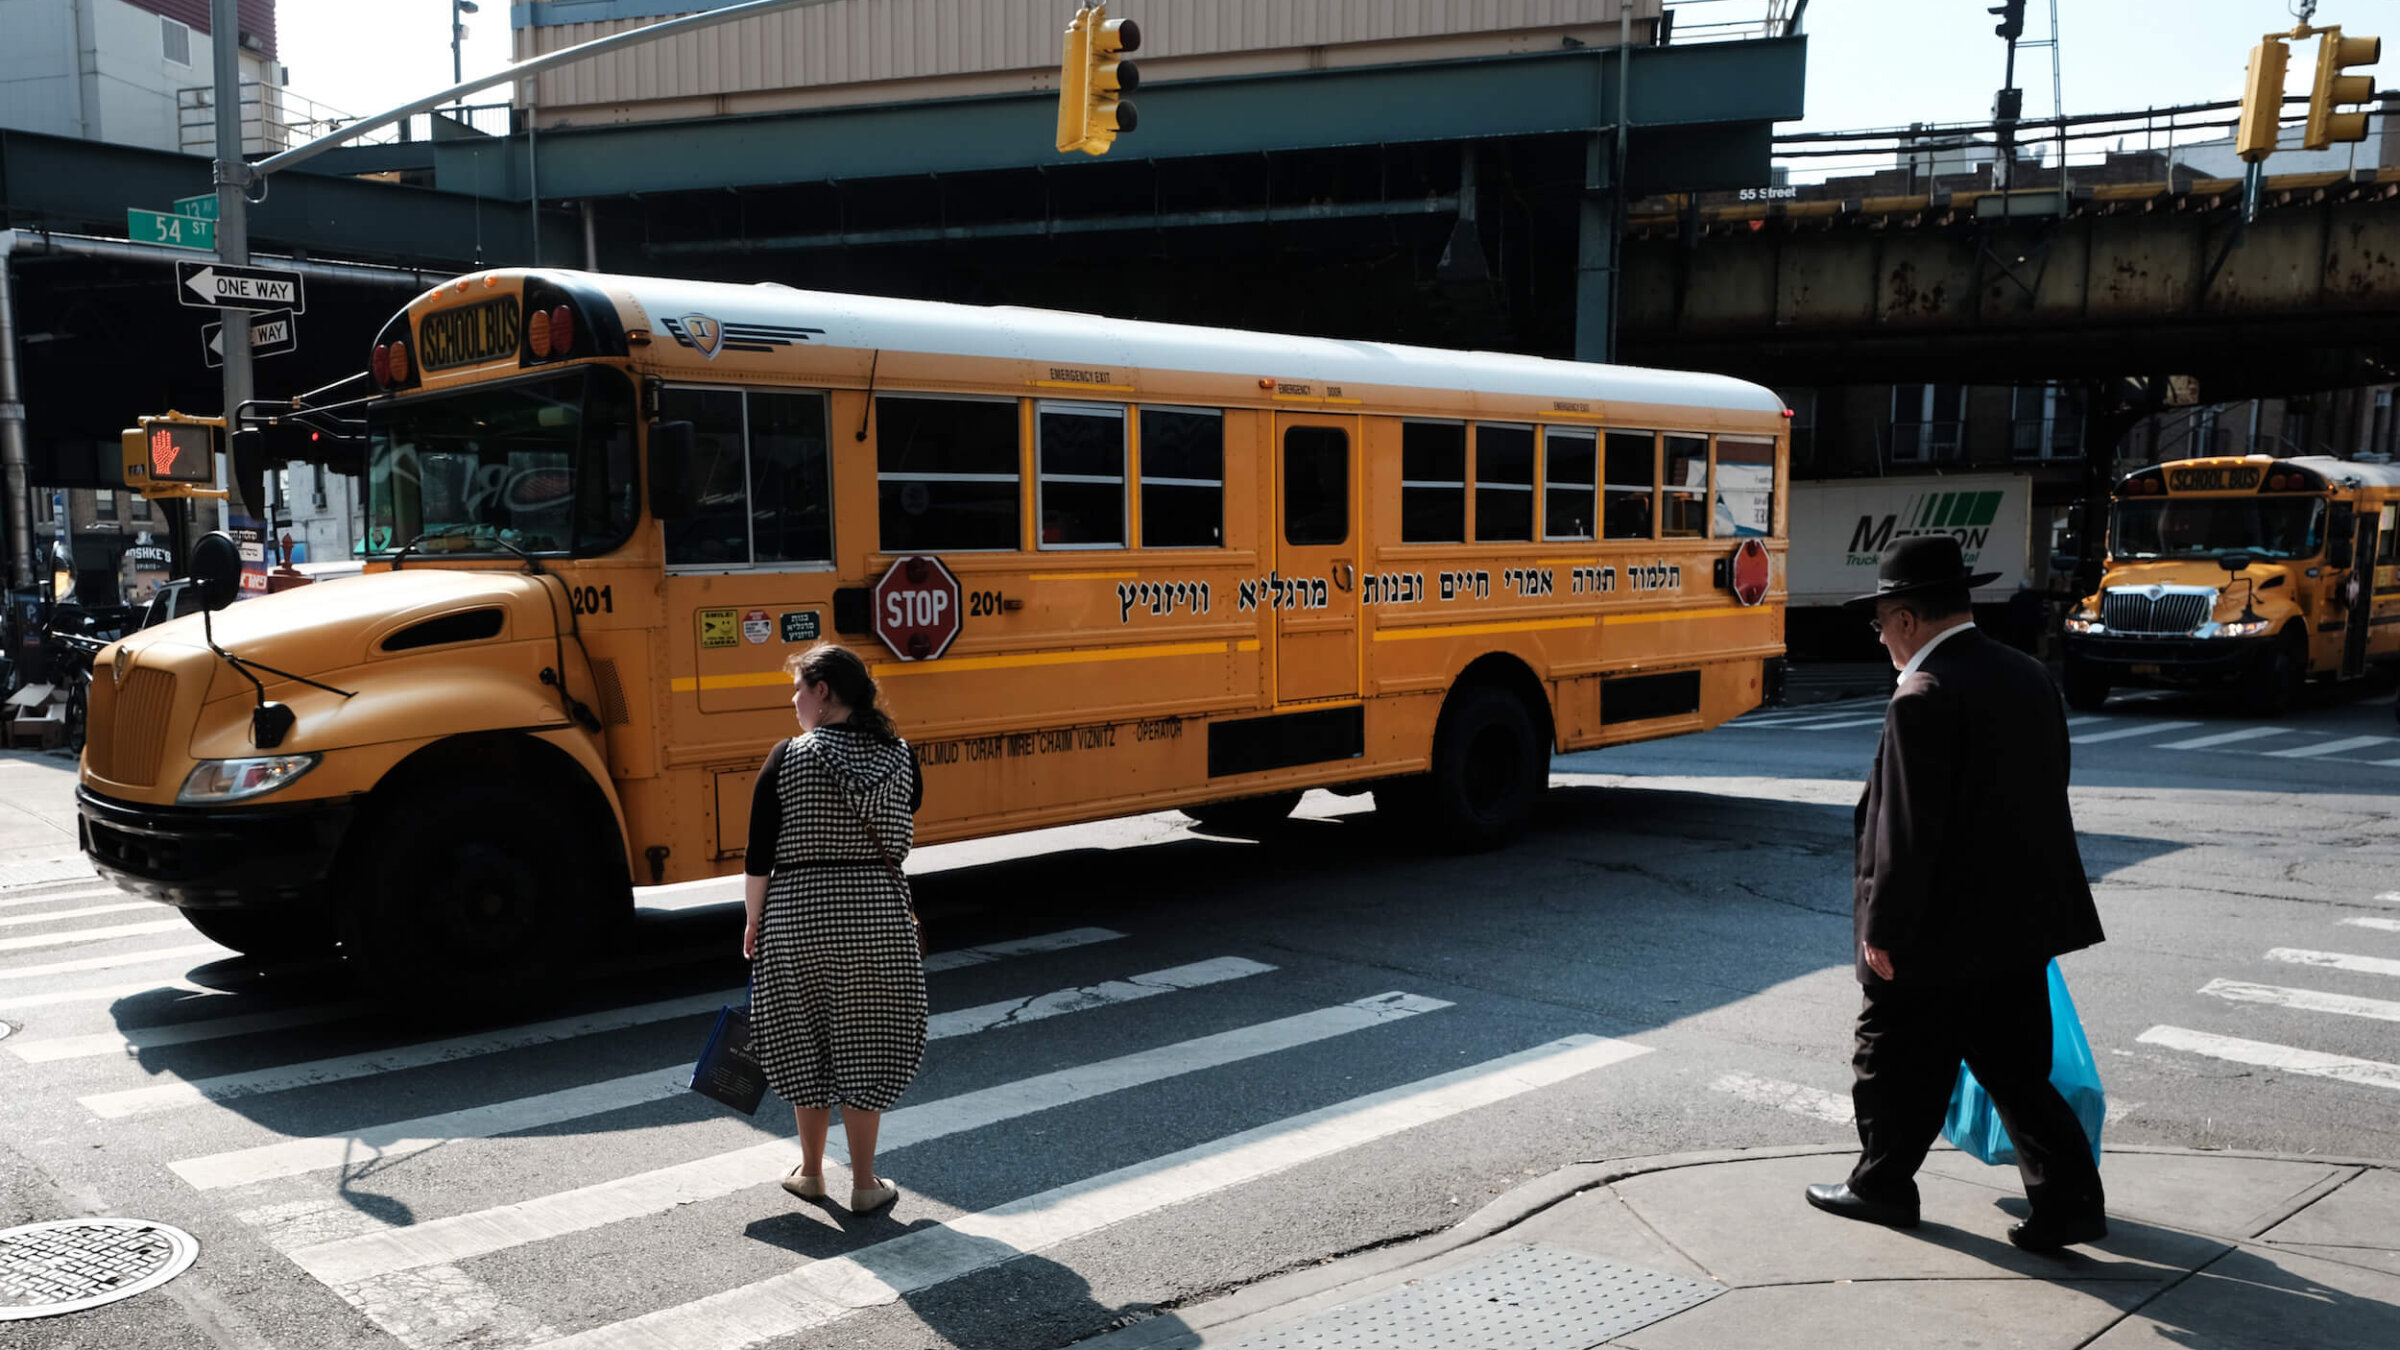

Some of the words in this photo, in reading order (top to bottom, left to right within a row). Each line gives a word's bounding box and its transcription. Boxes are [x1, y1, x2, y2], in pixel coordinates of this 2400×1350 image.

[1739, 188, 1757, 200] 55
[1759, 186, 1797, 199] Street
[185, 203, 200, 218] 13
[155, 216, 182, 243] 54
[192, 222, 206, 235] ST
[216, 278, 250, 296] ONE
[256, 281, 288, 299] WAY
[258, 323, 283, 343] WAY
[426, 305, 486, 367] SCHOOL
[486, 300, 520, 354] BUS
[1050, 368, 1094, 383] EMERGENCY
[1095, 371, 1110, 384] EXIT
[1278, 383, 1311, 396] EMERGENCY
[2173, 470, 2228, 490] SCHOOL
[2229, 468, 2259, 489] BUS
[124, 546, 172, 563] OSHKE'S
[1362, 571, 1424, 605] ובנות
[1438, 570, 1490, 601] חיים
[1503, 567, 1554, 597] אמרי
[1572, 566, 1617, 596] תורה
[1628, 559, 1681, 592] תלמוד
[574, 585, 613, 615] 201
[970, 591, 1003, 616] 201
[1117, 580, 1210, 624] וויזניץ
[1238, 571, 1328, 611] מרגליא
[886, 589, 949, 628] STOP
[914, 742, 959, 766] TALMUD
[965, 738, 1002, 762] TORAH
[1007, 735, 1036, 758] IMREI
[1040, 731, 1073, 754] CHAIM
[1078, 725, 1116, 750] VIZNITZ
[1136, 718, 1183, 743] OPERATOR
